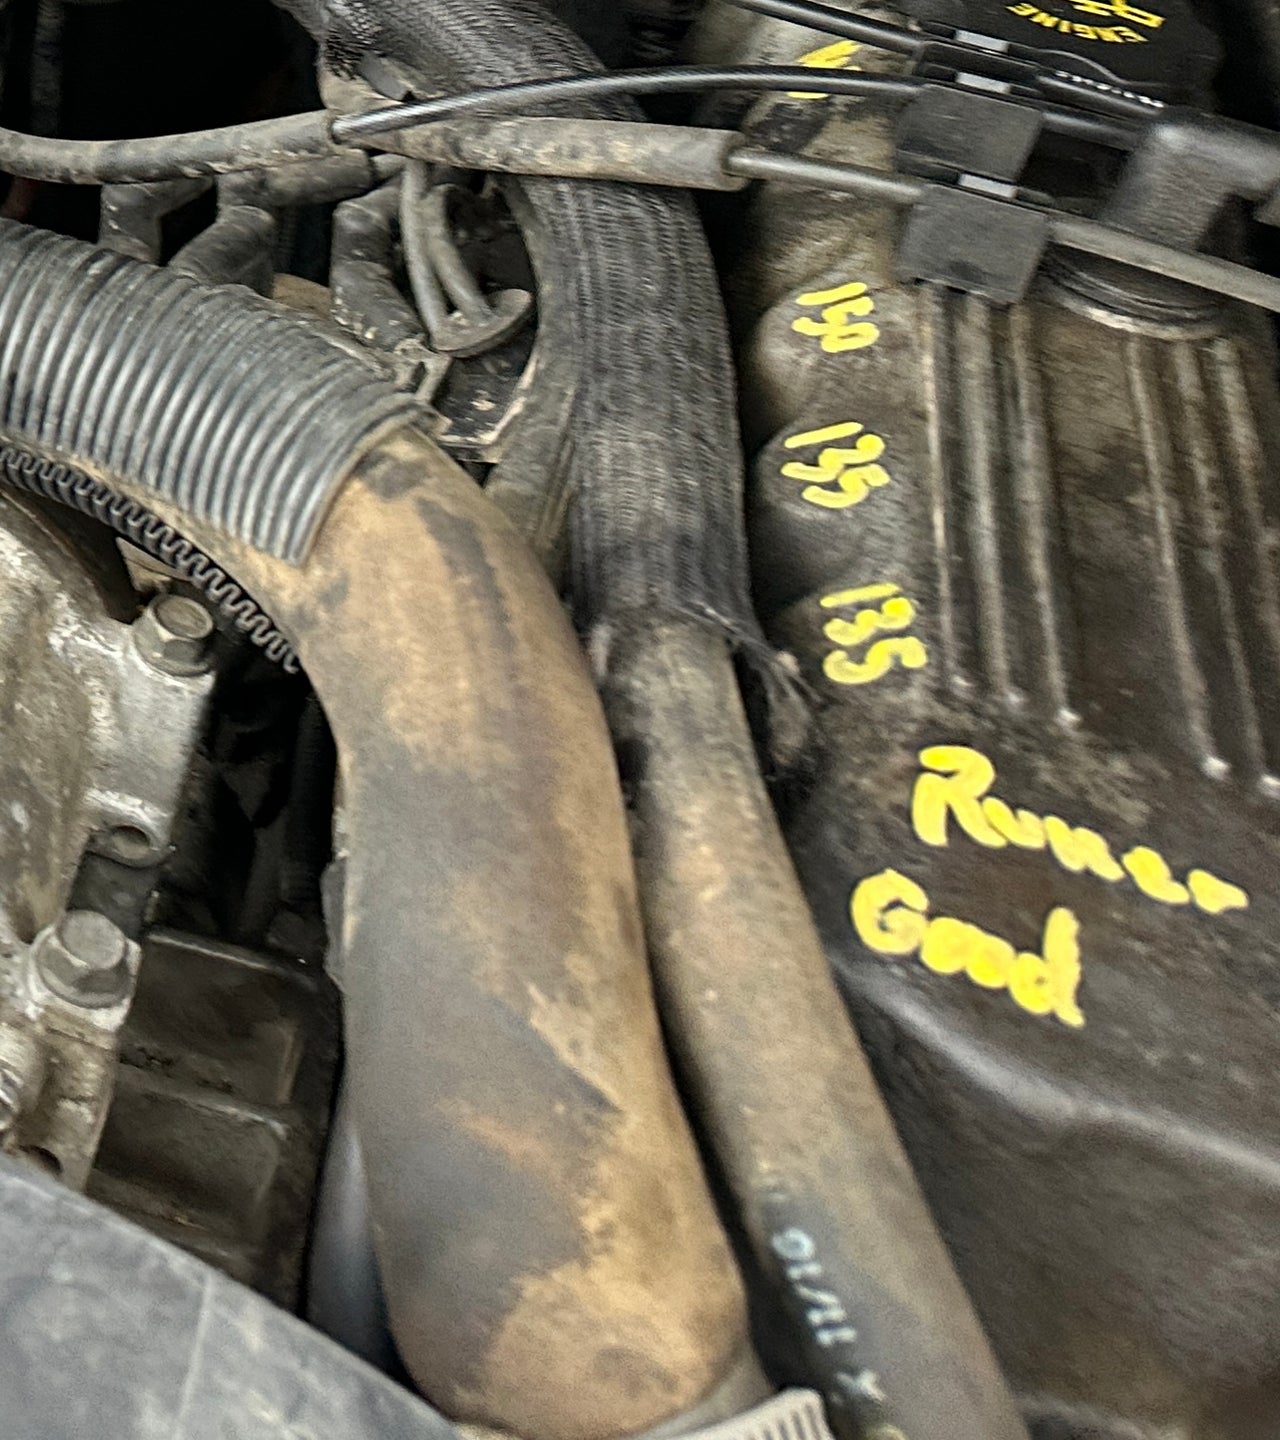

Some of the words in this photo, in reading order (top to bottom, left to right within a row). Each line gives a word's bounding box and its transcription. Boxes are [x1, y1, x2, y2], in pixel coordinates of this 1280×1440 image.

[1006, 1, 1149, 45] ENGINE
[780, 421, 887, 507] 135
[819, 582, 928, 684] 135
[851, 868, 1085, 1026] Good
